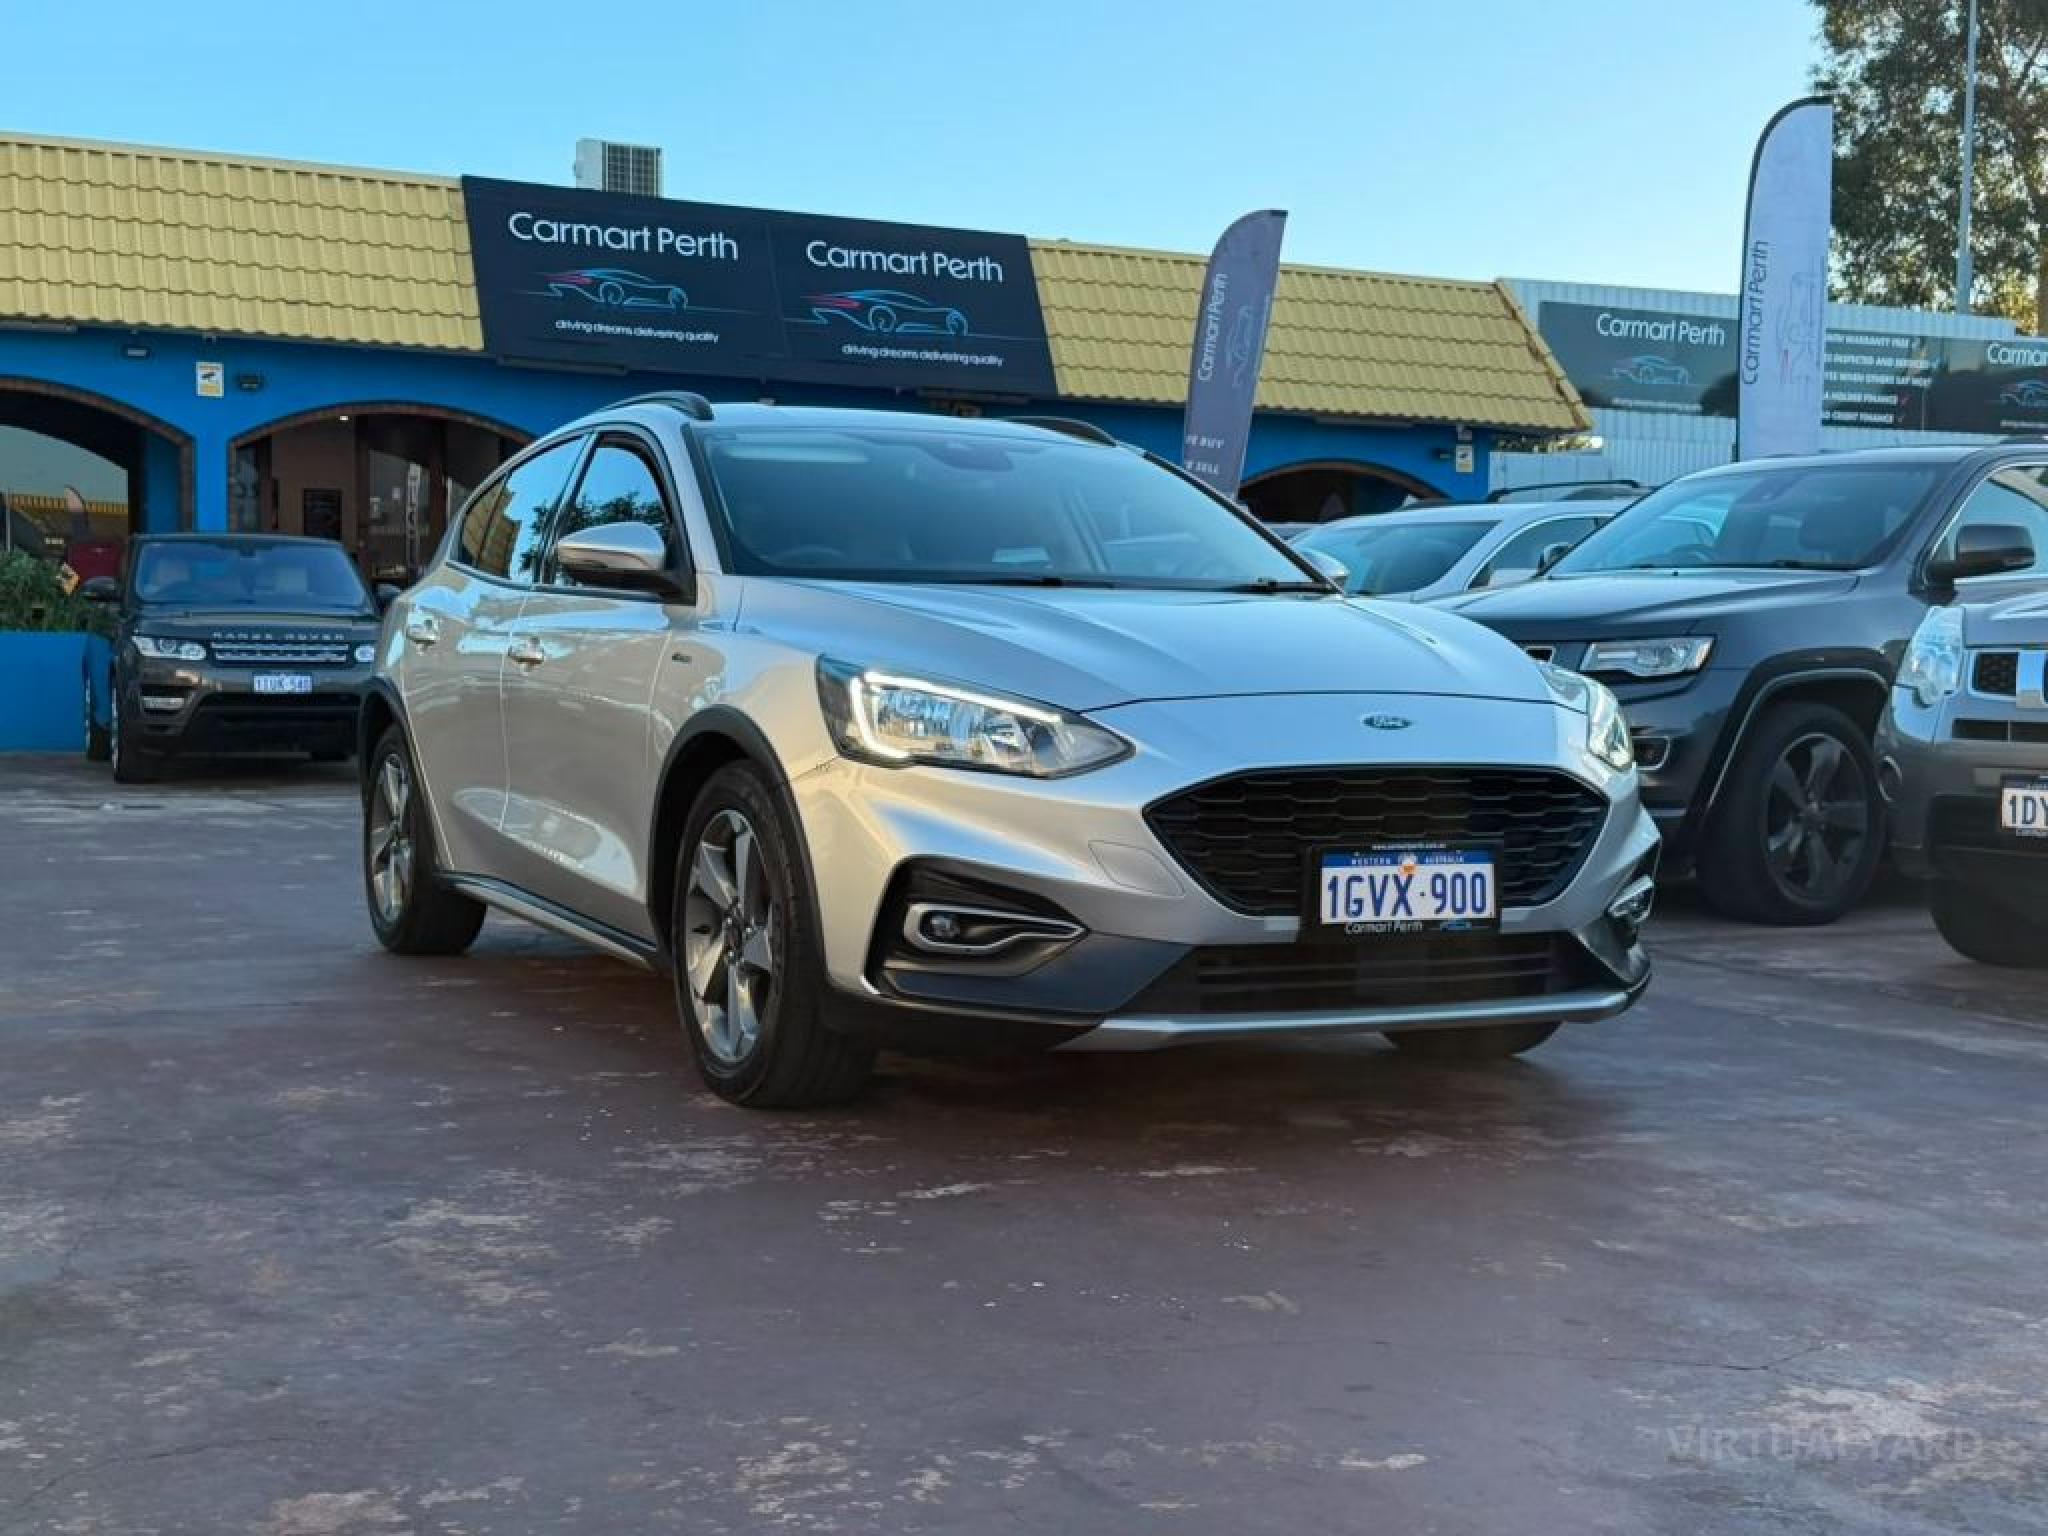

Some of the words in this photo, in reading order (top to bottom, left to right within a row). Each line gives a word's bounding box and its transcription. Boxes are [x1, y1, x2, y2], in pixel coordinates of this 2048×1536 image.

[509, 211, 650, 252] Carmart
[657, 227, 739, 260] Perth
[806, 240, 928, 275] Carmart
[933, 252, 1003, 283] Perth
[1748, 240, 1769, 295] Perth
[1208, 273, 1229, 314] Perth
[555, 319, 592, 334] driving
[593, 322, 633, 336] dreams
[633, 327, 685, 342] delivering
[685, 331, 719, 344] quality
[1198, 314, 1220, 382] Carmart
[1596, 313, 1676, 341] Carmart
[1678, 320, 1725, 345] Perth
[1743, 297, 1763, 384] Carmart
[841, 343, 878, 359] driving
[879, 347, 919, 360] dreams
[919, 350, 969, 365] delivering
[970, 354, 1003, 367] quality
[1352, 857, 1391, 866] WESTERN
[1425, 855, 1464, 864] AUSTRALIA
